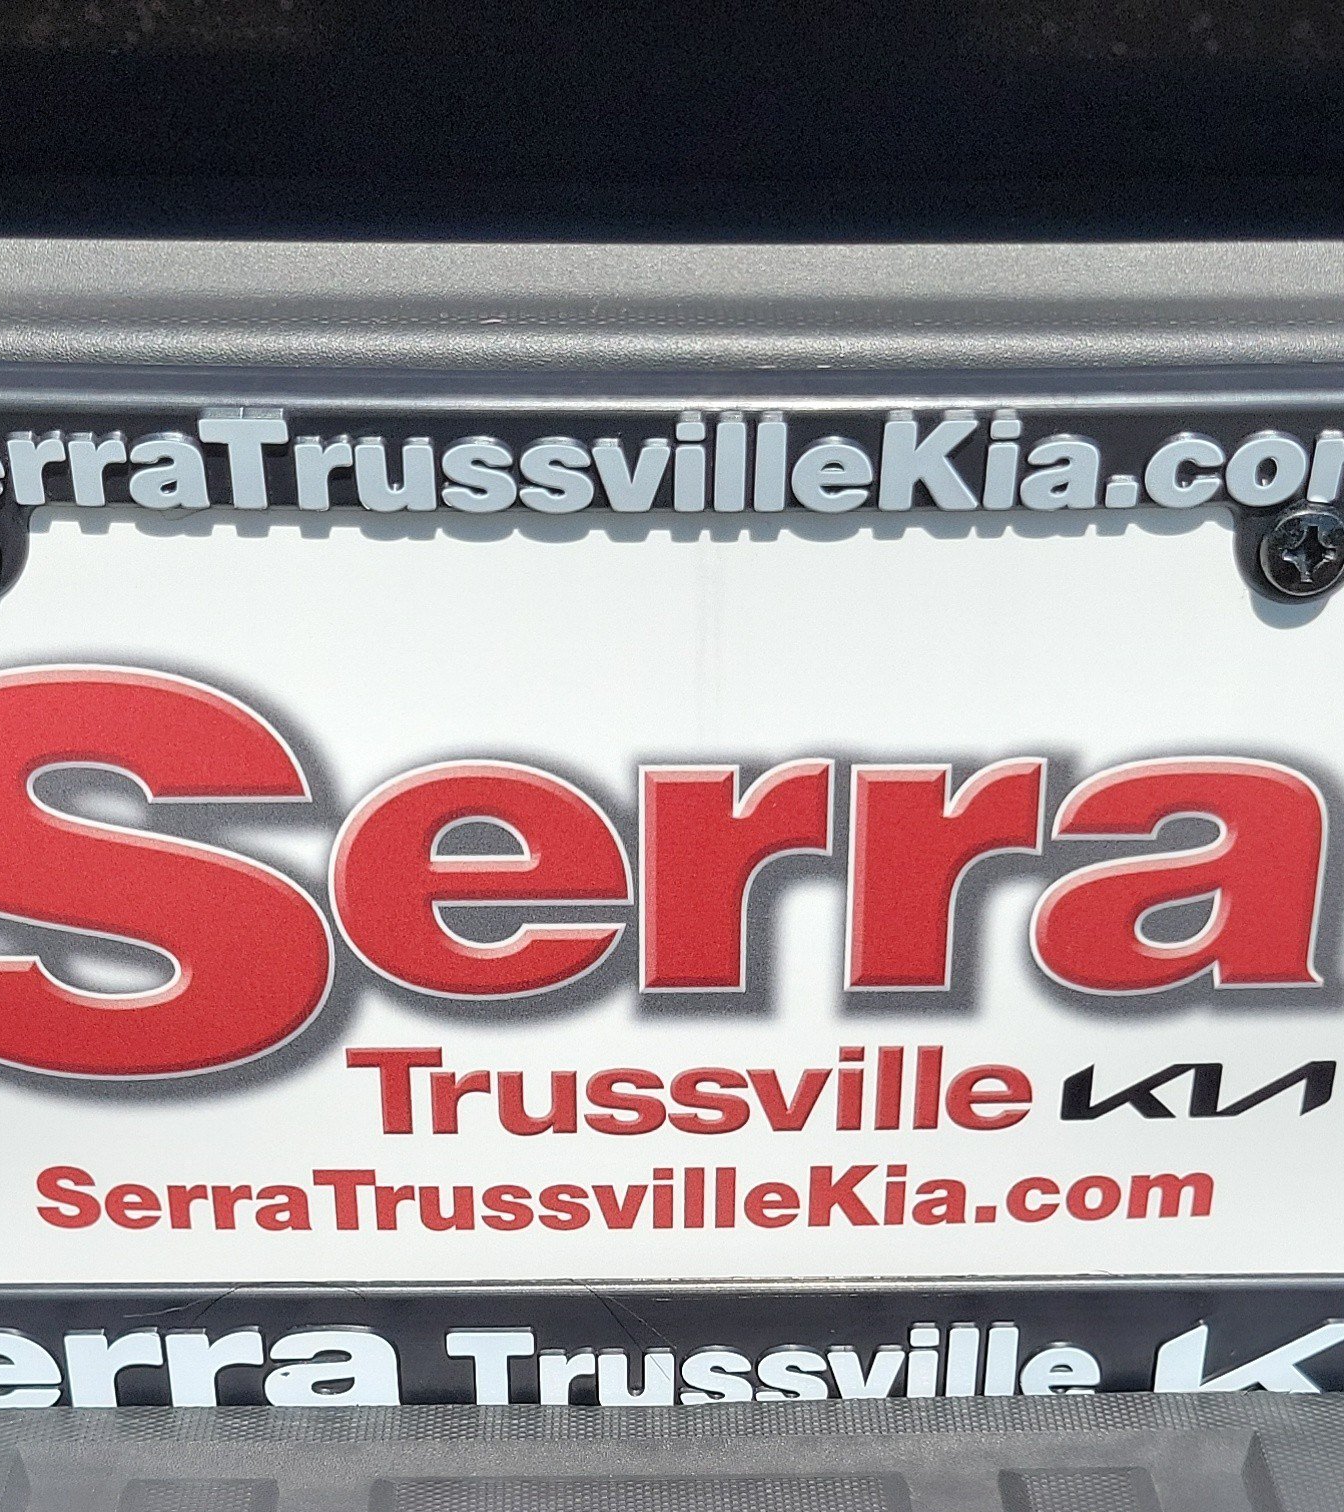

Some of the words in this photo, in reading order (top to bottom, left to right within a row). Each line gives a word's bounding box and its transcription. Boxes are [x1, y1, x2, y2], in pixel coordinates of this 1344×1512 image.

[346, 1045, 1034, 1135] Trussville
[35, 1163, 1216, 1232] SerraTrussvilleKia.com
[446, 1321, 1102, 1408] Trussville
